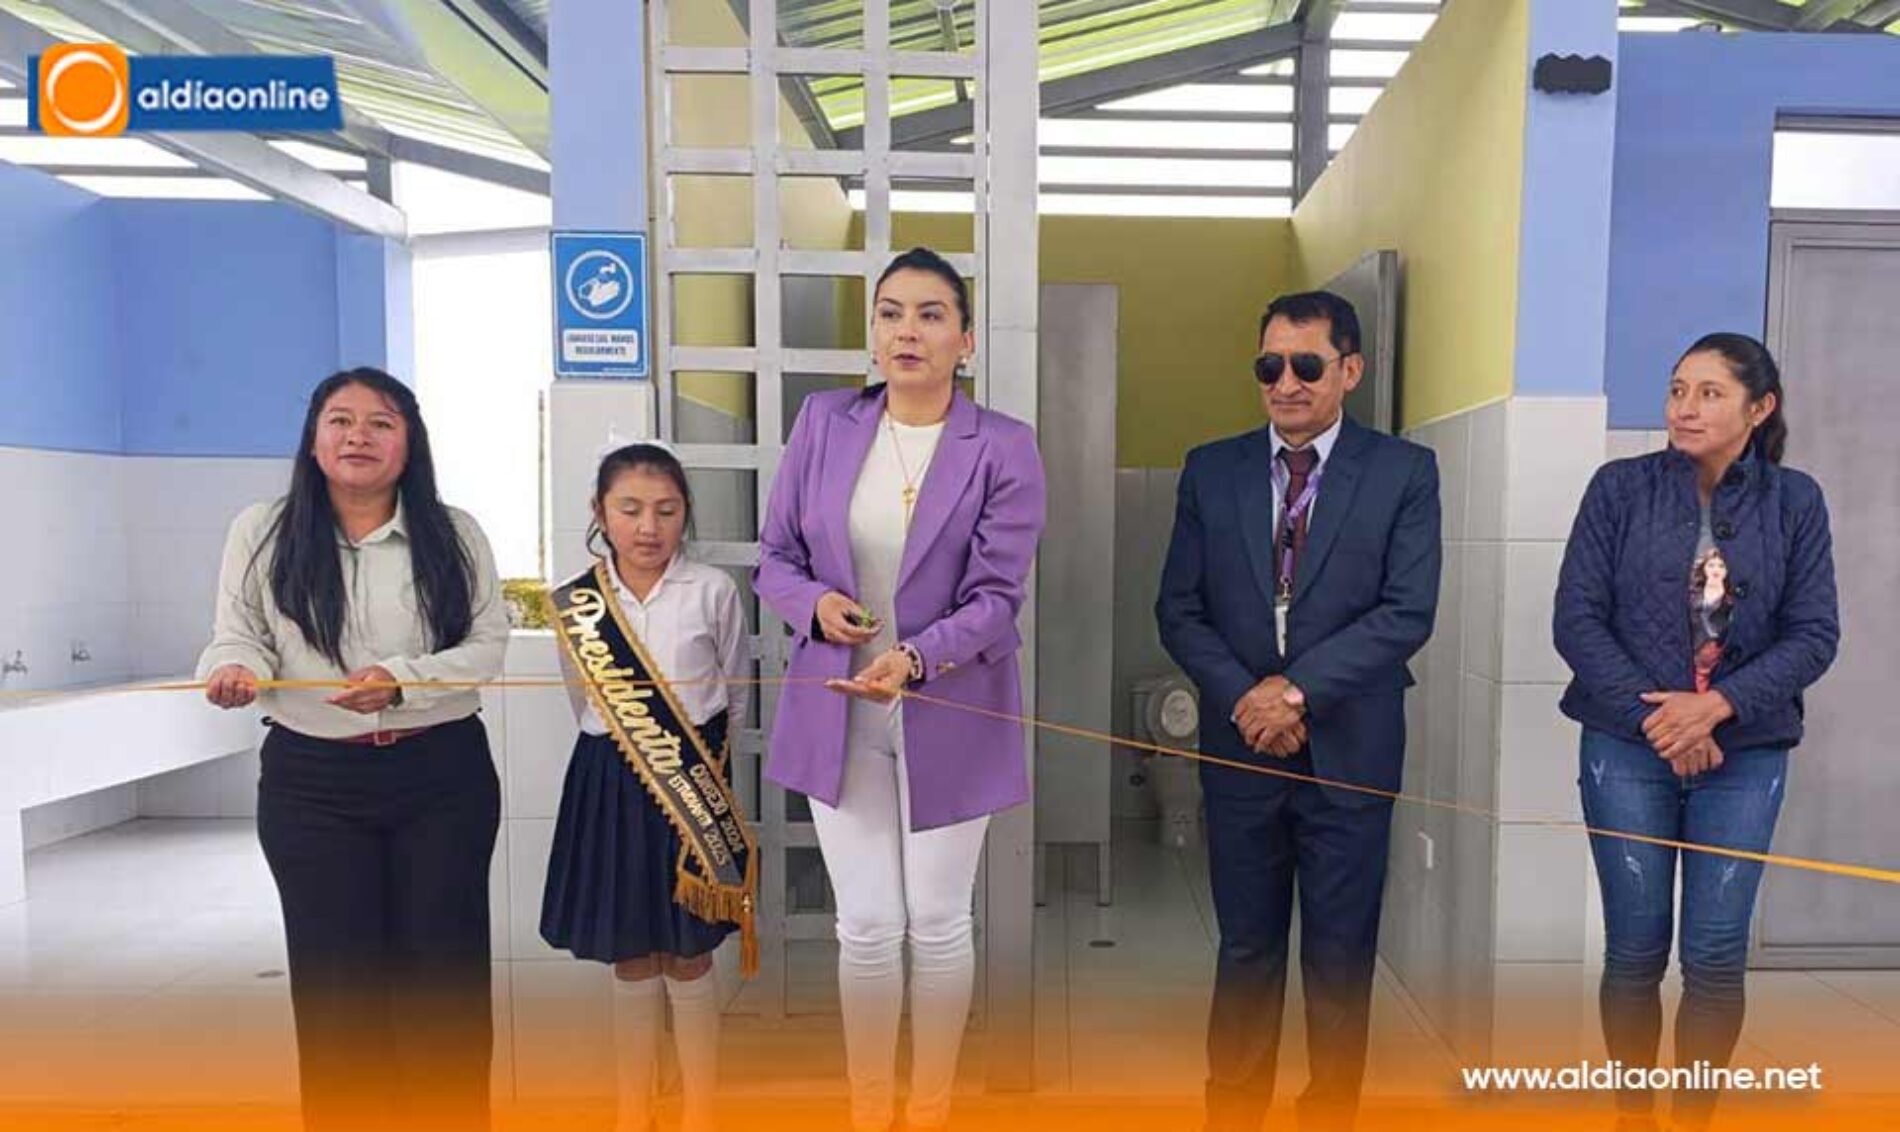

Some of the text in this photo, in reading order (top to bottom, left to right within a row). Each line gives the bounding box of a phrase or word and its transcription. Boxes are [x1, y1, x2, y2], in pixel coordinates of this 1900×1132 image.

[560, 588, 683, 774] Presidenta
[703, 829, 728, 866] 2025
[720, 816, 745, 853] 2024
